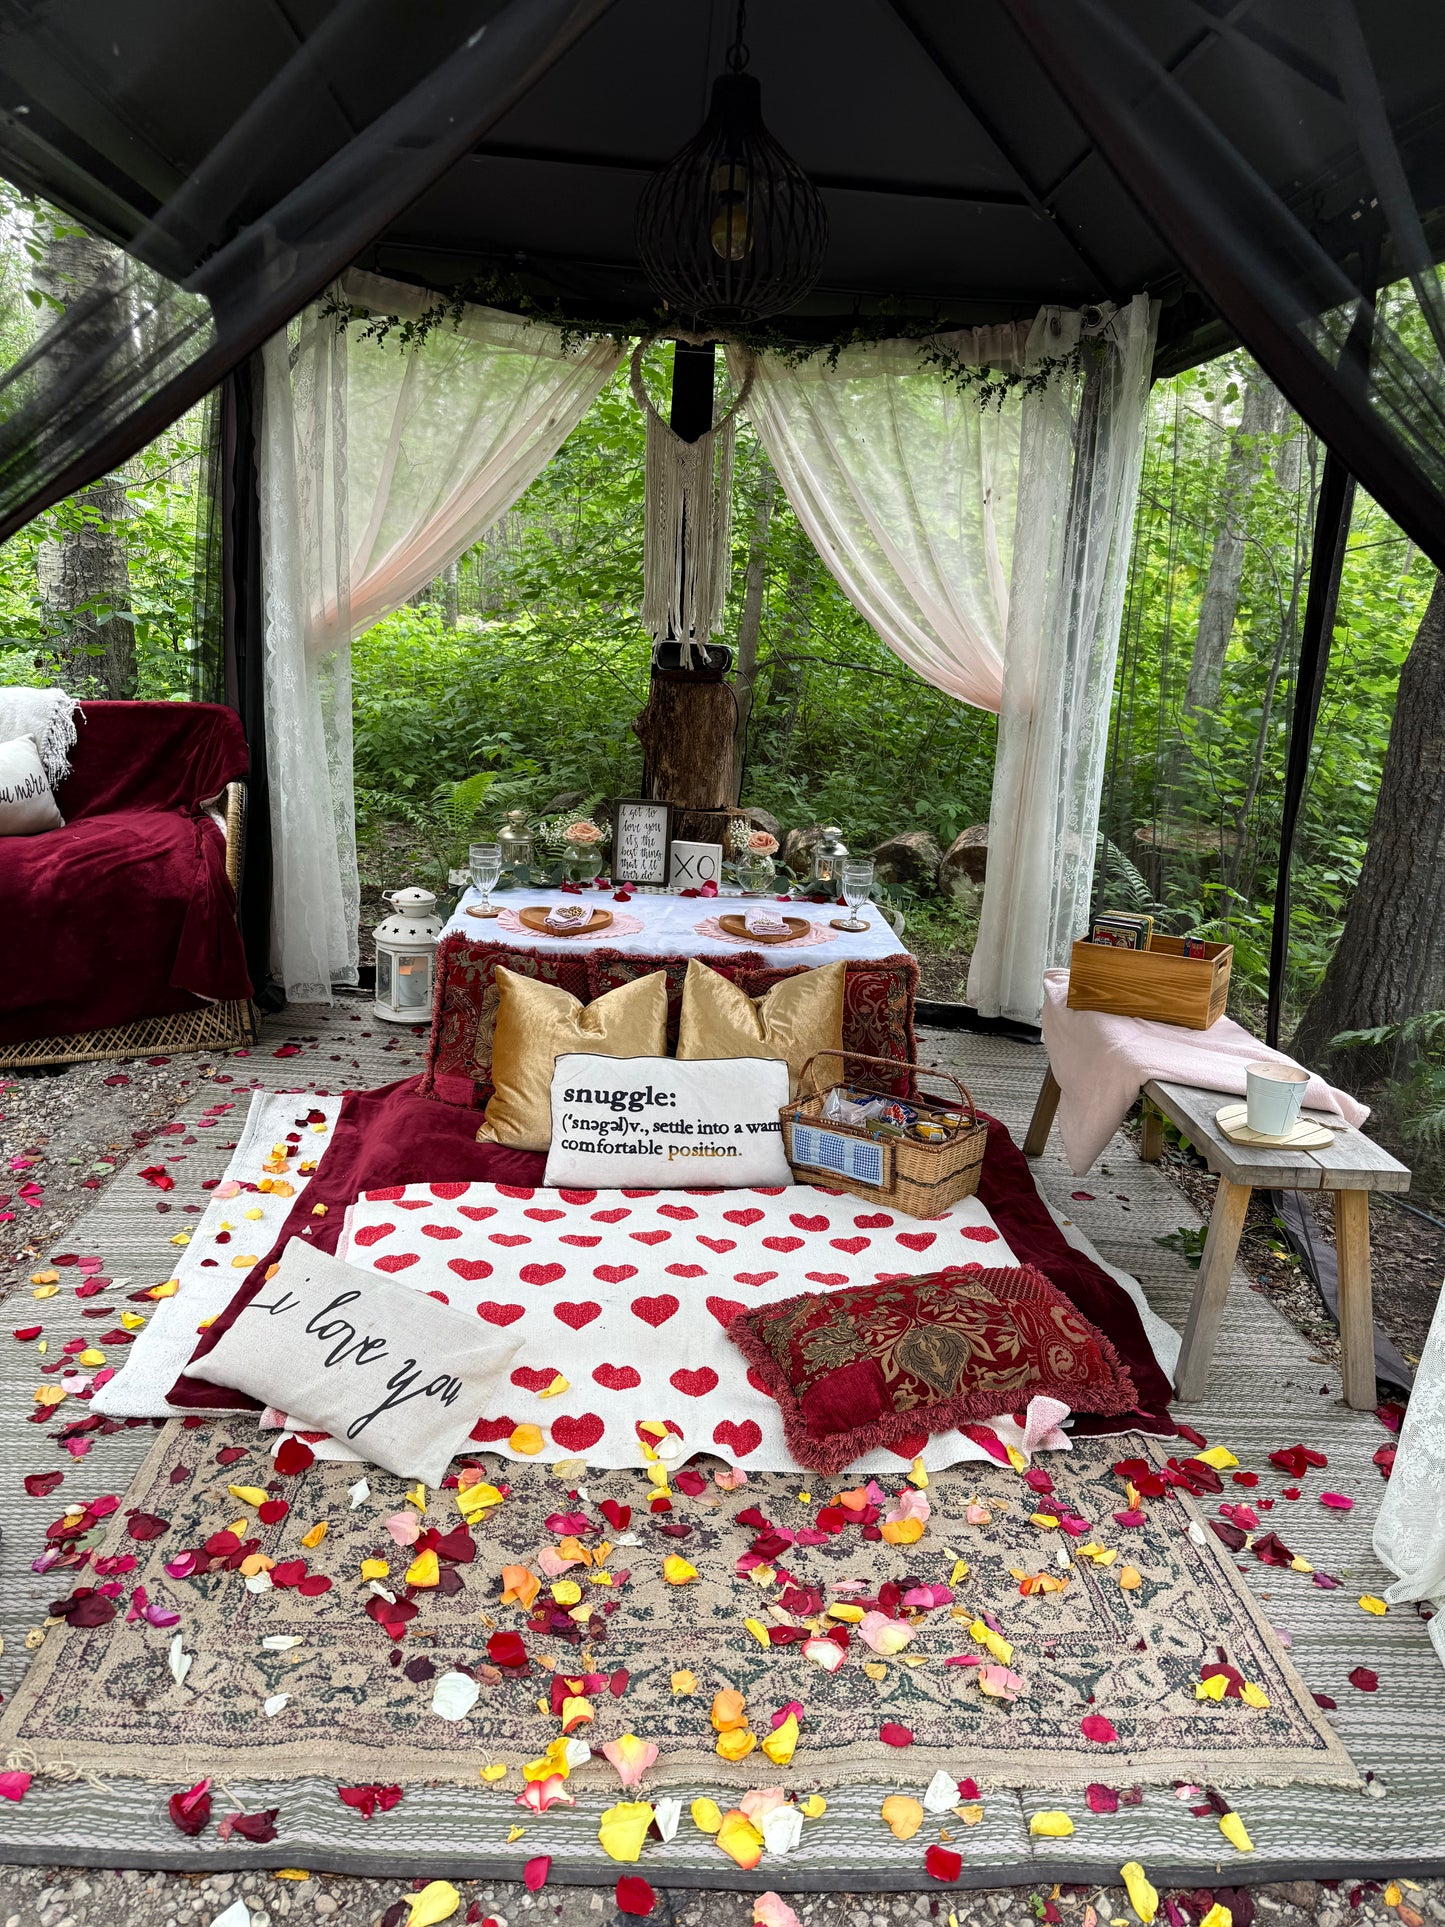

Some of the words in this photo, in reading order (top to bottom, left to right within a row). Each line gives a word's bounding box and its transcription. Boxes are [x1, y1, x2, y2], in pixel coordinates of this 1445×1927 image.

[0, 786, 14, 803] u
[646, 808, 657, 818] to
[622, 820, 641, 833] love
[644, 823, 661, 835] you
[641, 835, 655, 848] the
[620, 846, 637, 859] best
[640, 848, 662, 861] thing
[620, 859, 638, 869] that
[674, 853, 716, 880] XO
[622, 870, 639, 880] ever
[563, 1085, 676, 1112] snuggle:
[653, 1119, 694, 1135] settle
[697, 1119, 729, 1135] into
[733, 1124, 744, 1133] a
[561, 1138, 663, 1155] comfortable
[668, 1142, 743, 1161] position.
[306, 1290, 389, 1367] love
[346, 1358, 463, 1439] you
